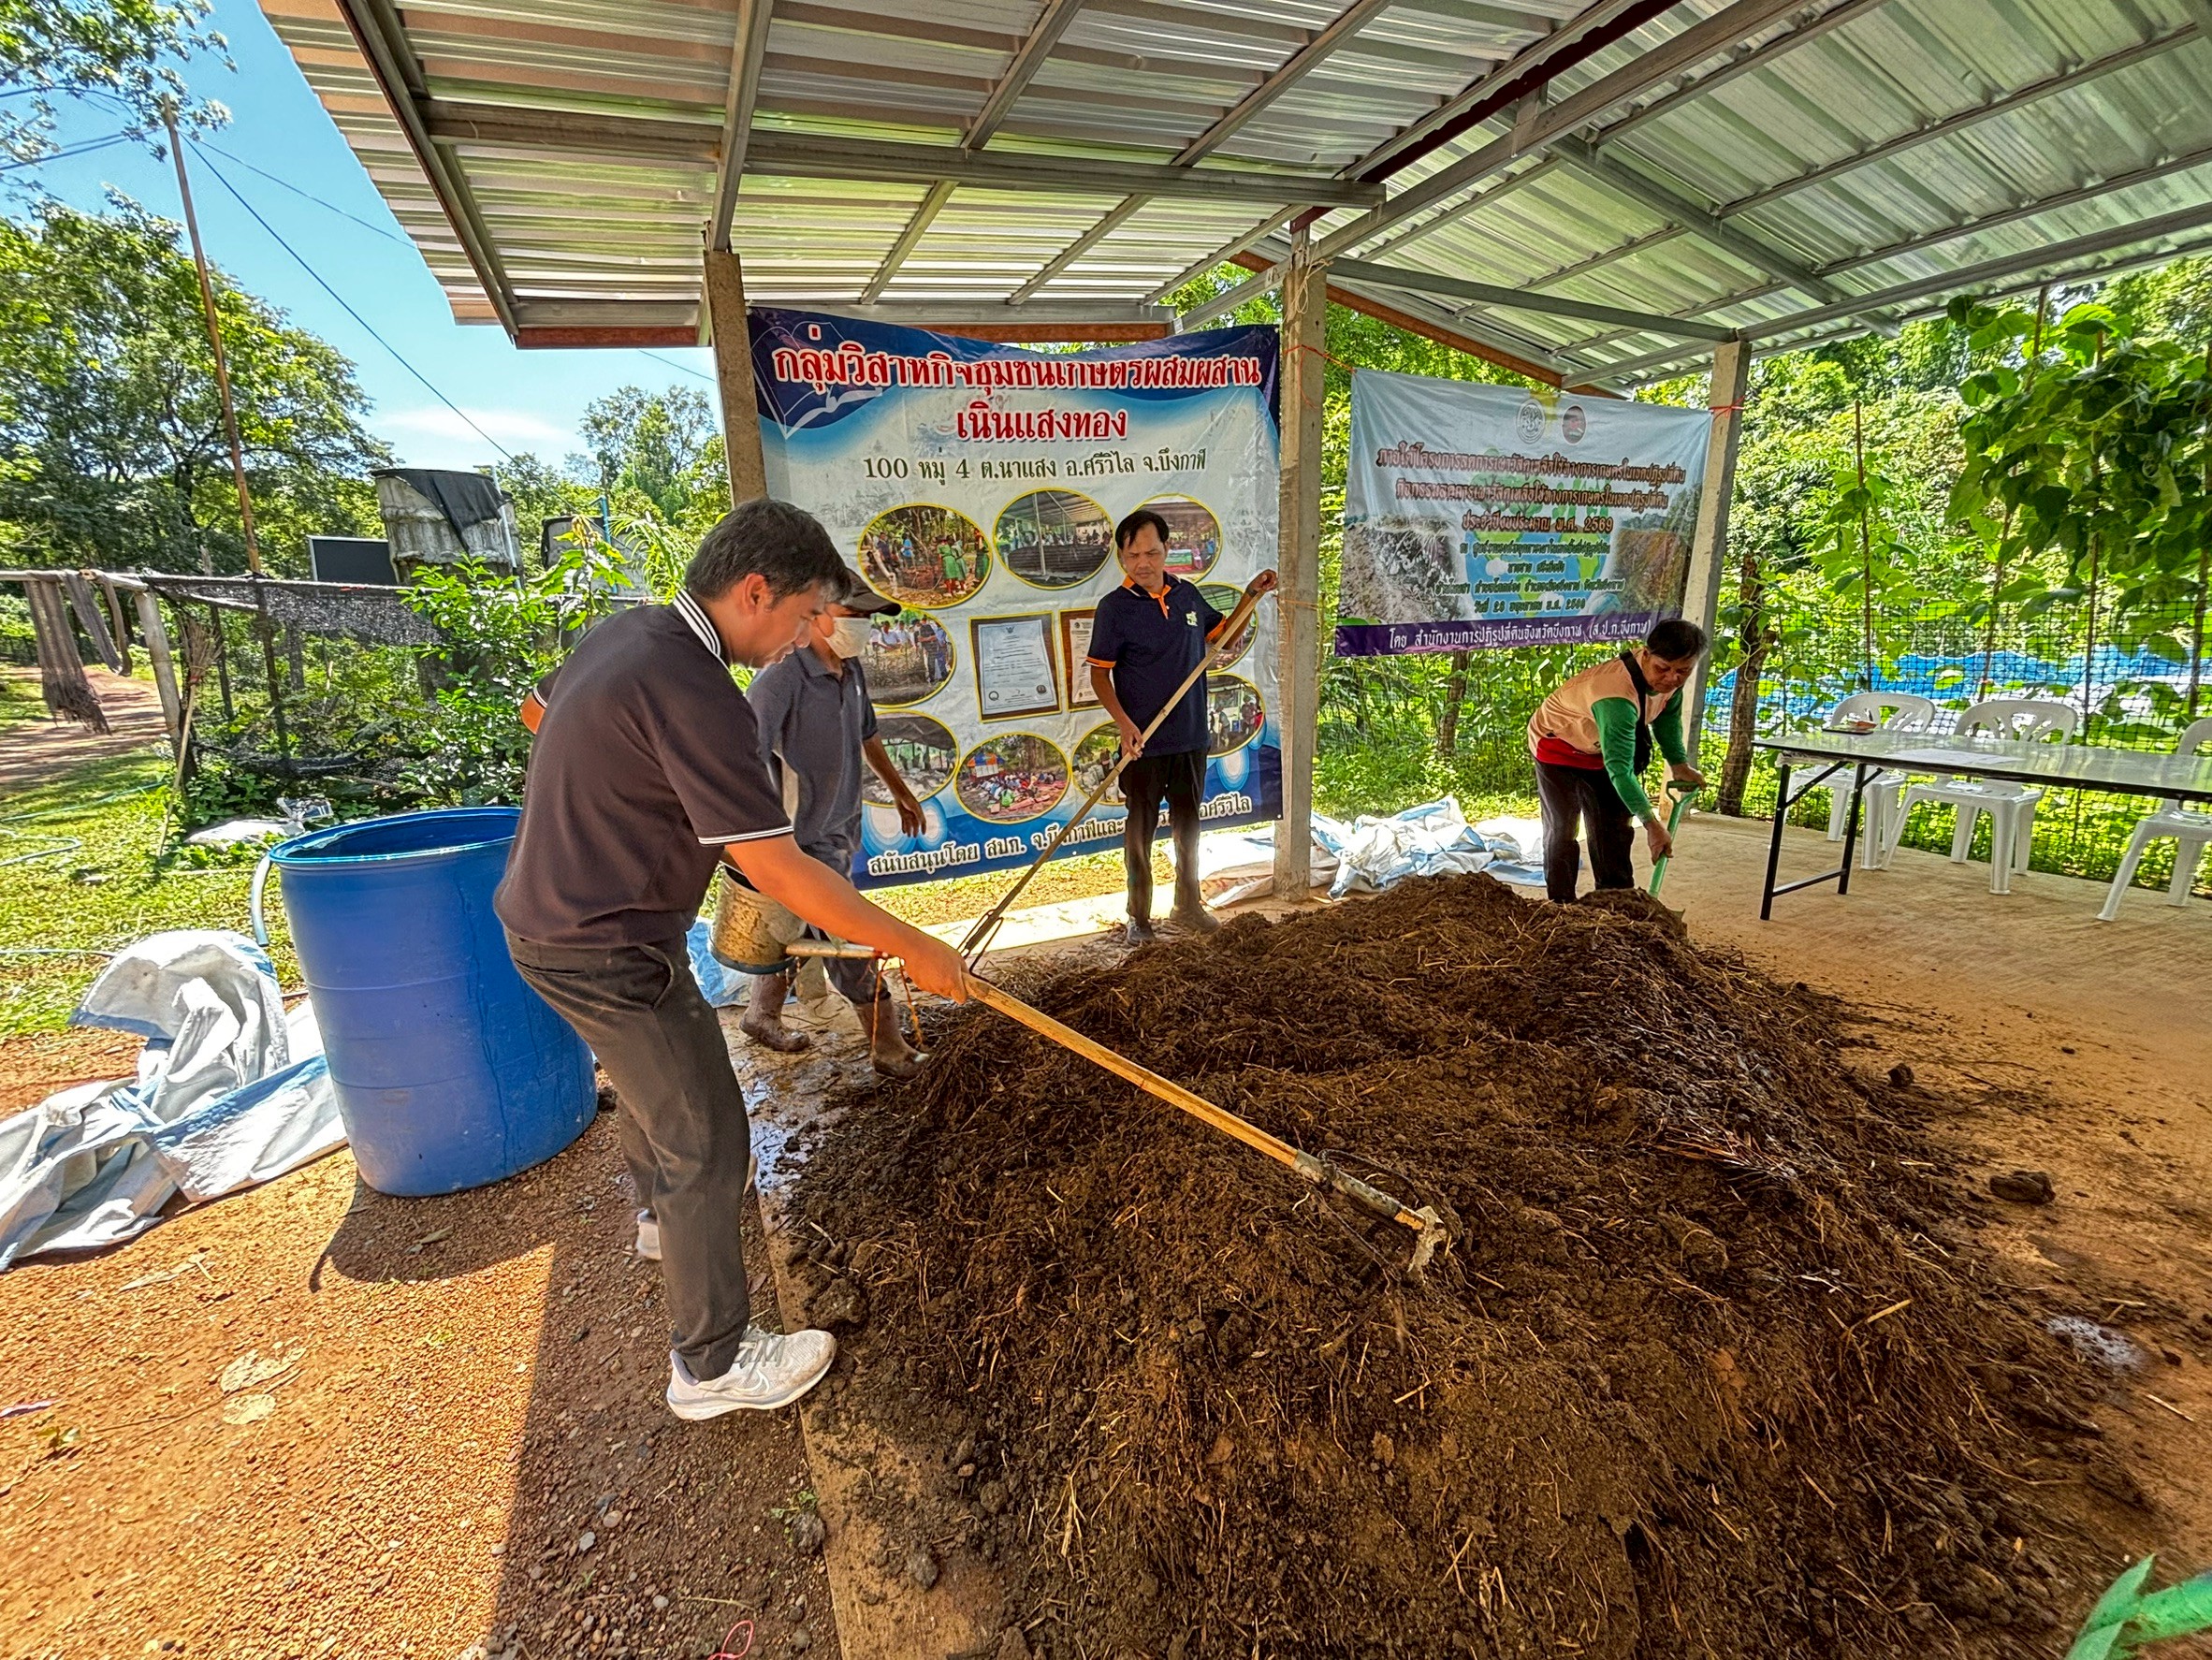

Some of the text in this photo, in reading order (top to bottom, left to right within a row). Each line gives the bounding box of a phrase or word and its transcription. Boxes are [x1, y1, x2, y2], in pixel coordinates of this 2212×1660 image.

[773, 325, 1261, 395] กลุ่มวิสาหกิจชุมชนเกษตรผสมผสาน
[955, 400, 1128, 441] เนินแสงทอง
[864, 458, 909, 480] 100
[918, 446, 946, 486] หมู่
[955, 459, 971, 479] 4
[982, 457, 1056, 480] ต.นาแสง
[1065, 449, 1135, 477] อ.ศรีวิไล
[1583, 516, 1615, 533] 2569
[1390, 627, 1407, 649] โดย
[869, 841, 980, 875] สนับสนุนโดย
